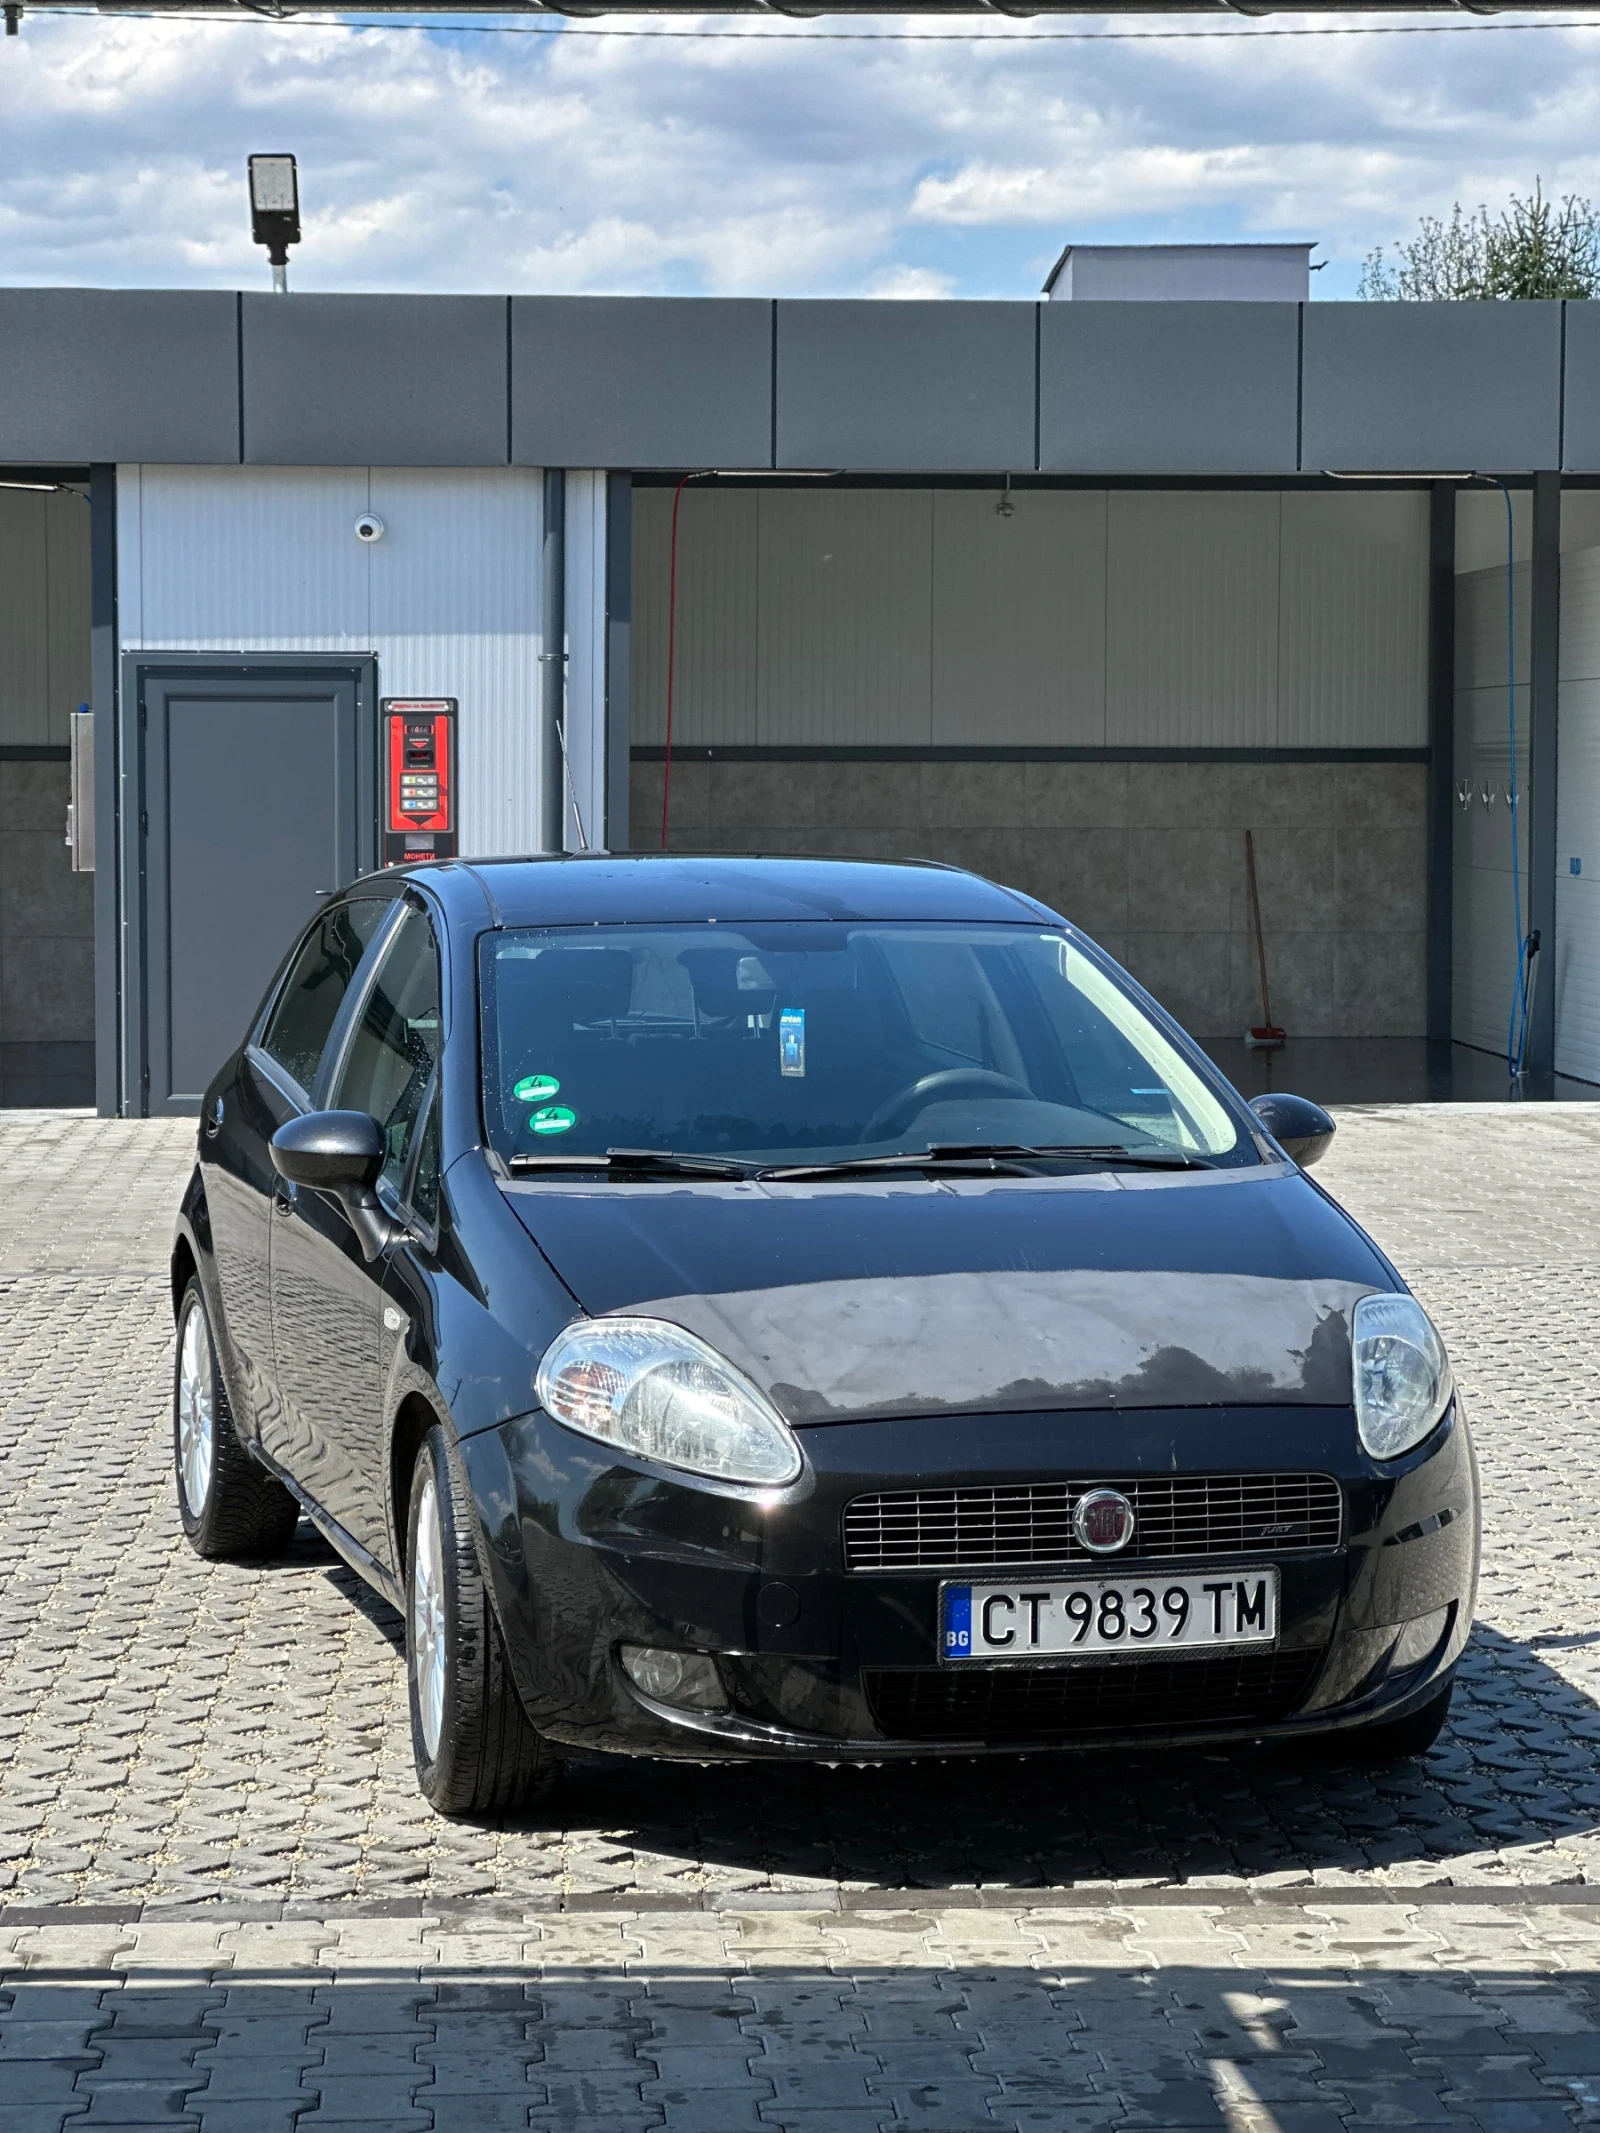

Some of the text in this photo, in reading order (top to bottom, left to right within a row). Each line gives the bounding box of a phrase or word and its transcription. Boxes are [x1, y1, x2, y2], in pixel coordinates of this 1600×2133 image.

[545, 1108, 559, 1120] 4
[982, 1580, 1267, 1645] CT 9839 TM
[946, 1630, 969, 1647] BG
